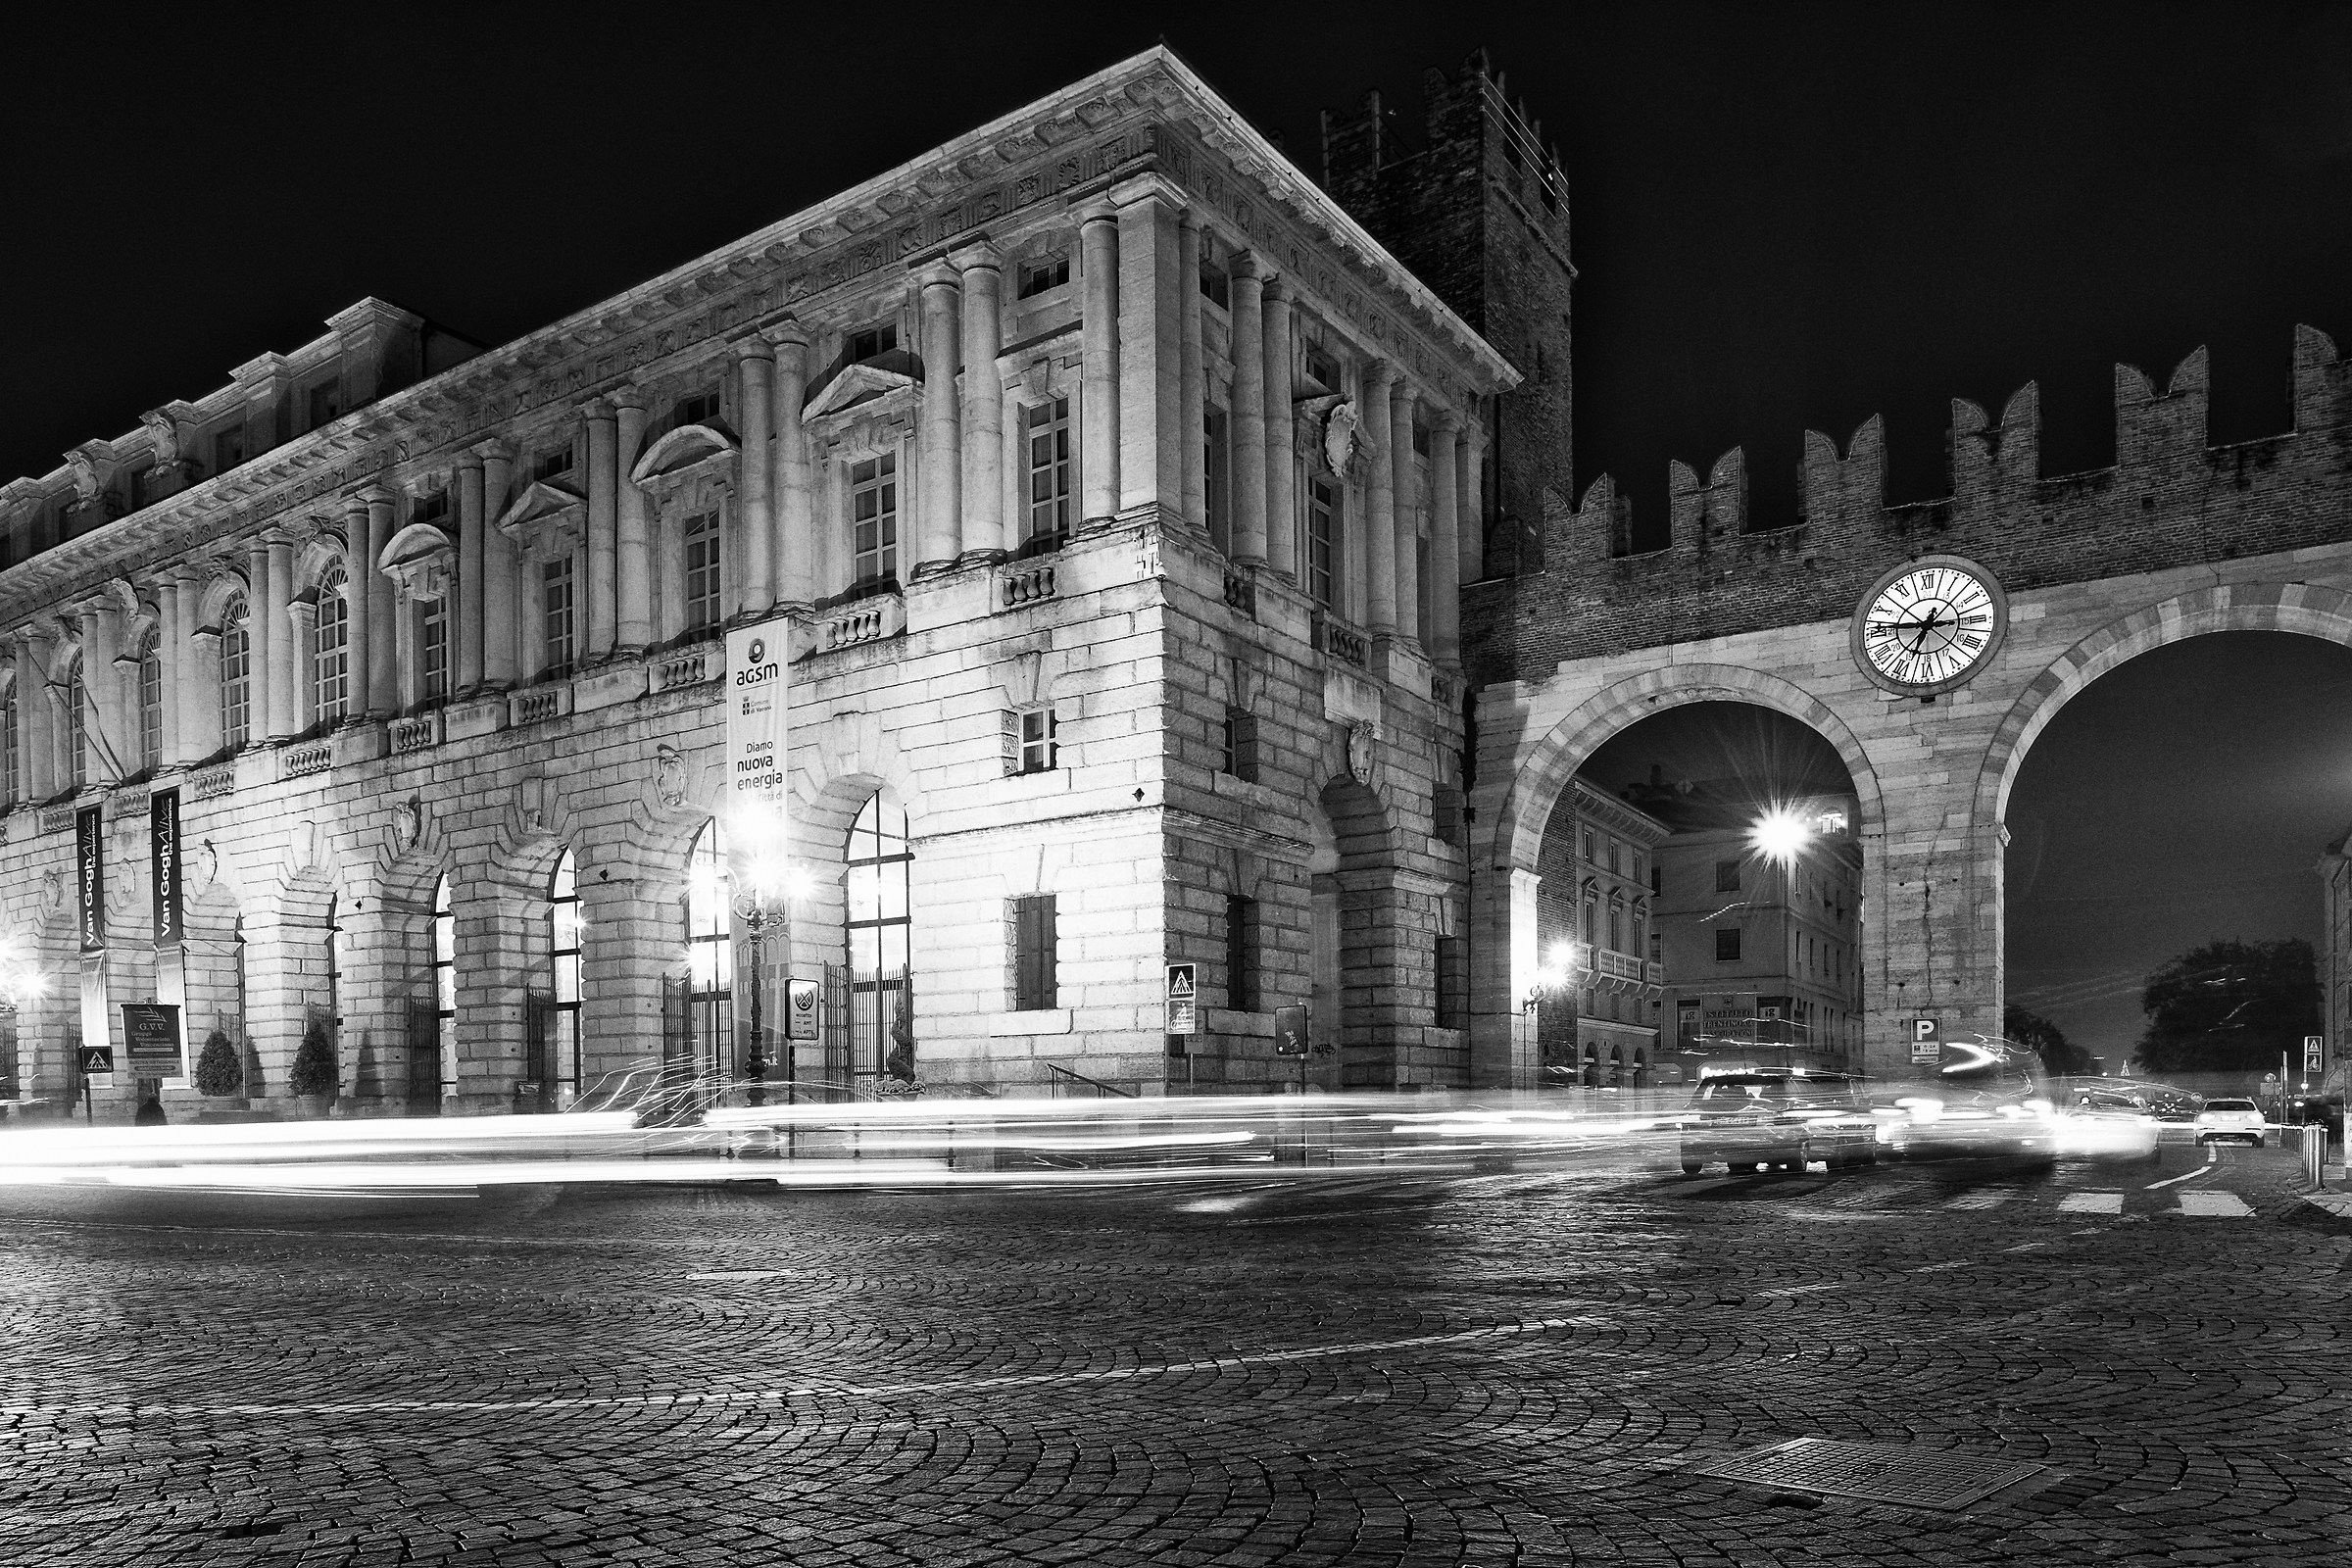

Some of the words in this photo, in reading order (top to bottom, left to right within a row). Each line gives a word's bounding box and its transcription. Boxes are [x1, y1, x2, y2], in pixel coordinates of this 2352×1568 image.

[1921, 573, 1935, 590] XII
[1895, 583, 1910, 599] XI
[1969, 613, 1986, 625] III
[1956, 633, 1965, 643] 16
[1962, 634, 1982, 650] IIII
[1942, 648, 1950, 657] 17
[1891, 659, 1910, 677] VII
[1921, 662, 1935, 678] VI
[1949, 656, 1961, 668] V
[746, 741, 773, 754] Diamo
[737, 755, 773, 772] nuova
[737, 768, 783, 791] energia
[160, 900, 171, 938] Van
[86, 910, 95, 946] Van
[1917, 1021, 1934, 1040] P
